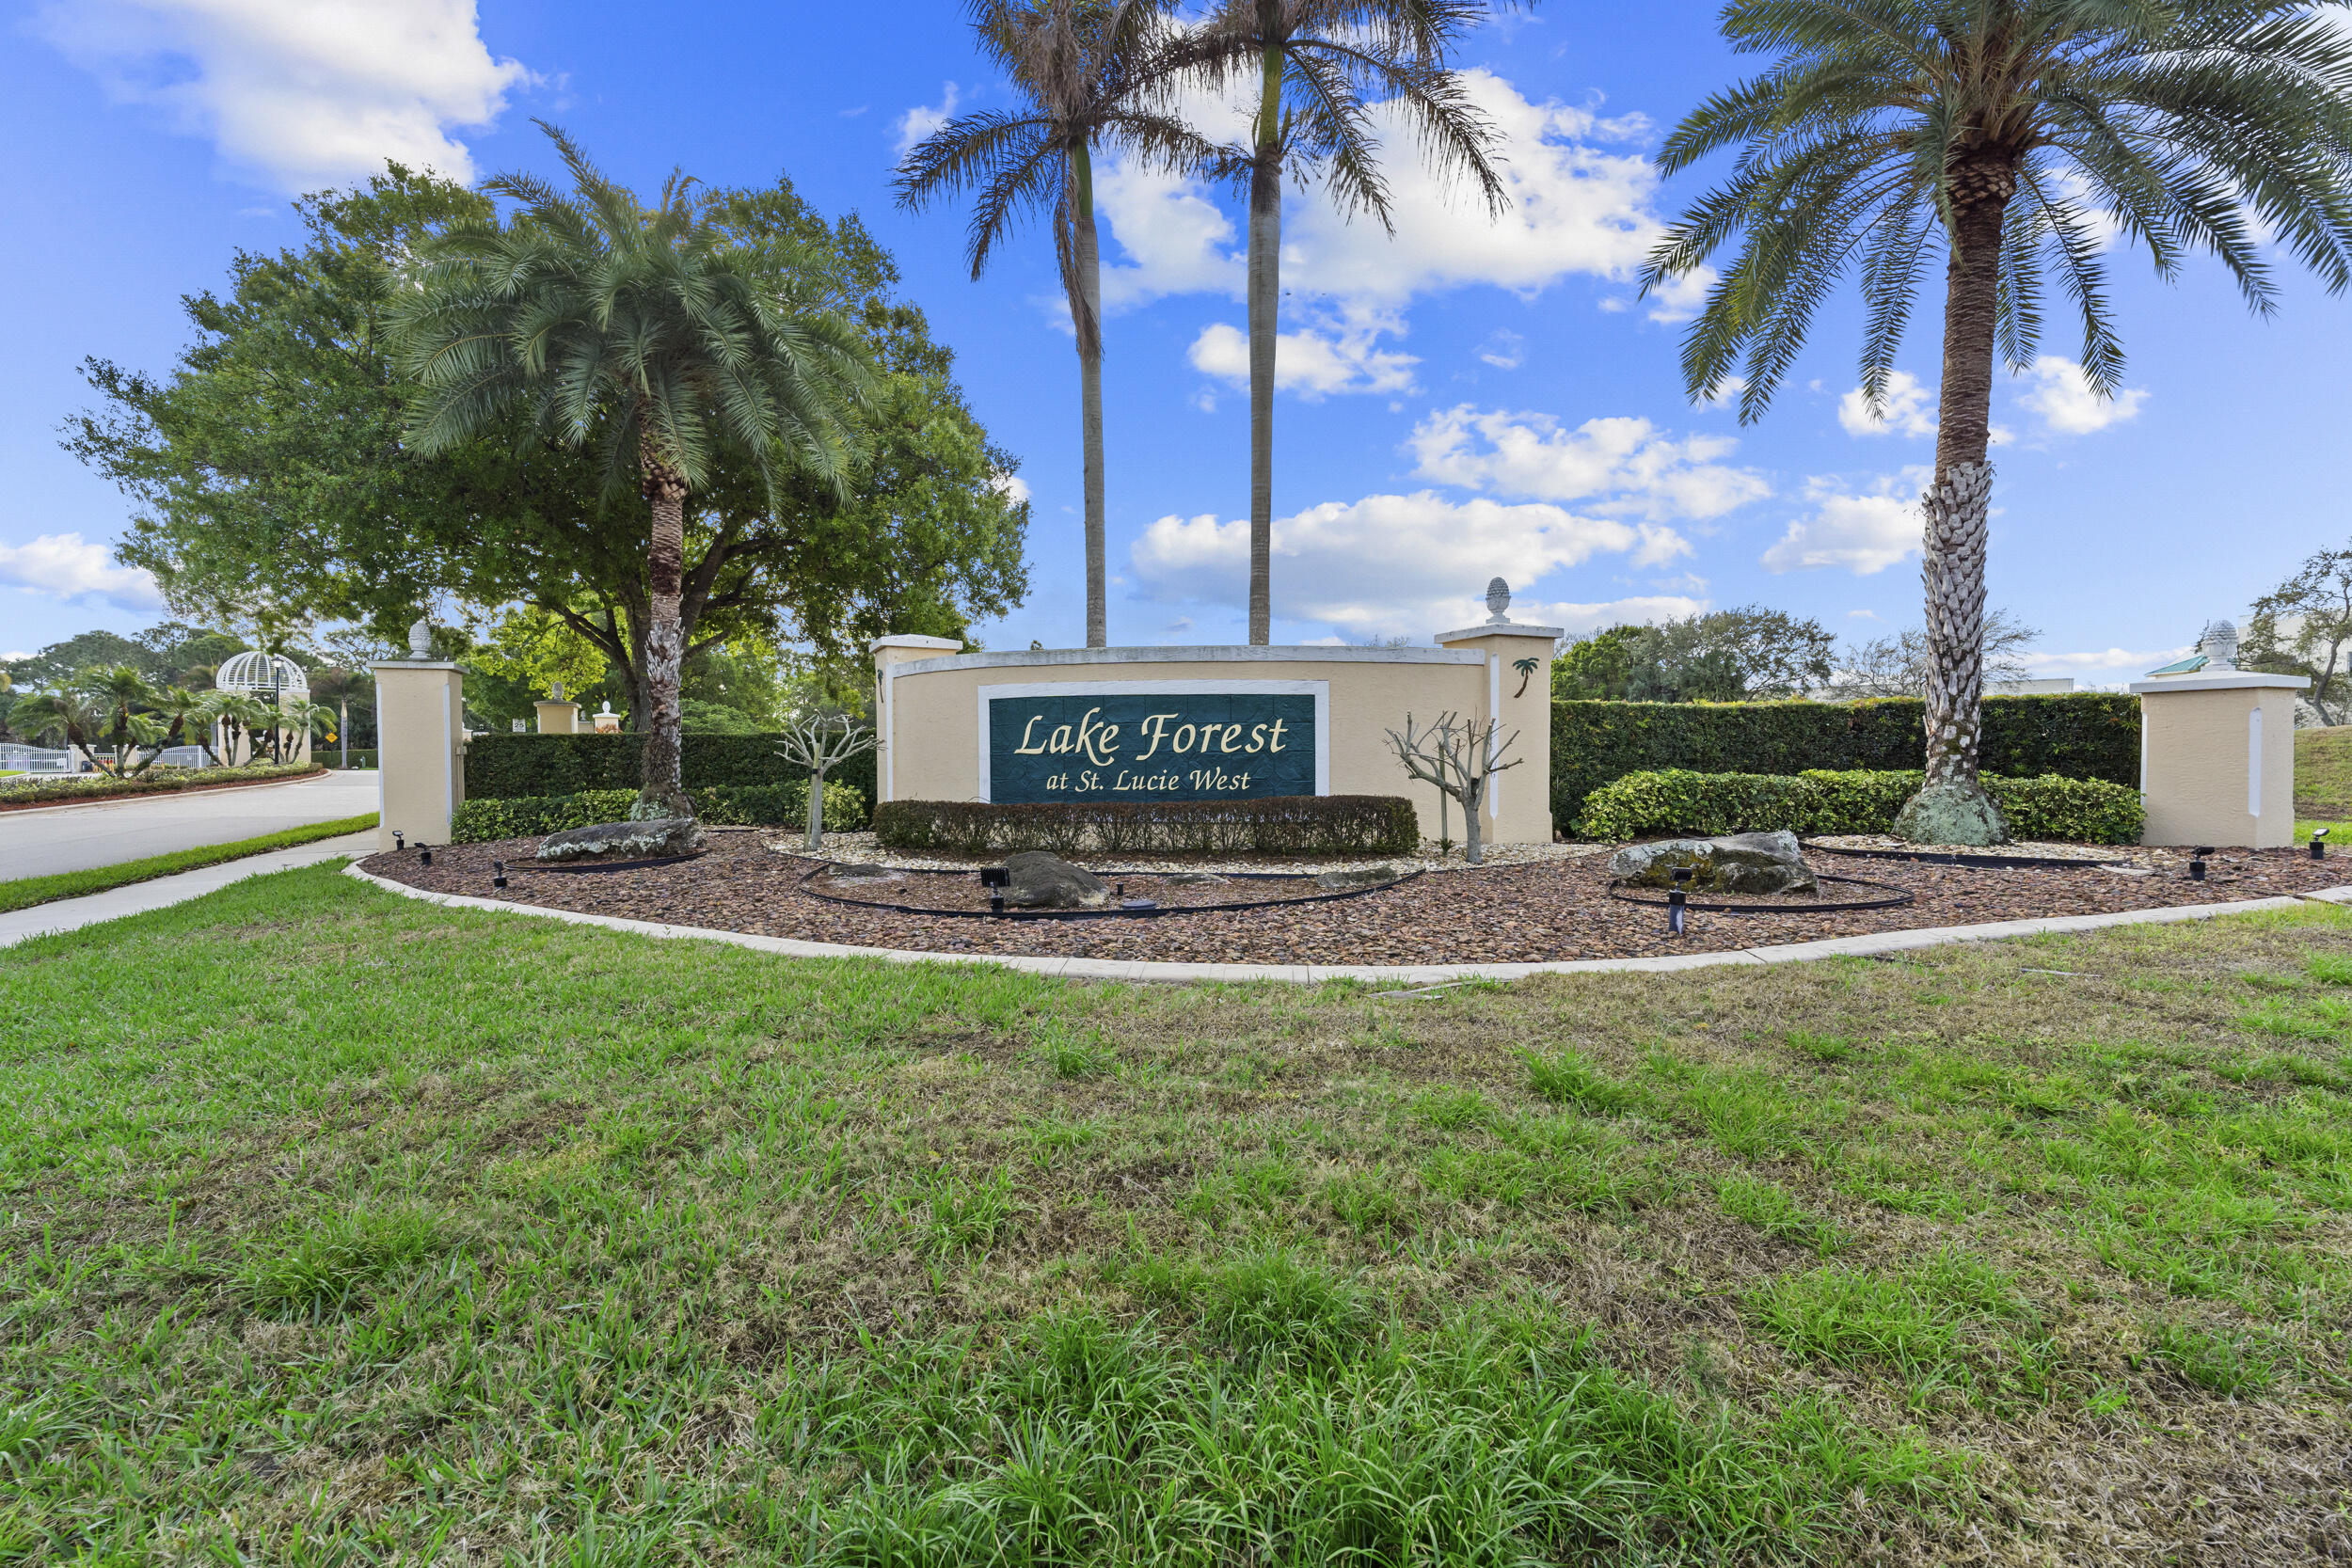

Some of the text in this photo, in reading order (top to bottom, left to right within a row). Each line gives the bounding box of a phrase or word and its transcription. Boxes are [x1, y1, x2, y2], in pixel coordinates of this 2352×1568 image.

[1014, 707, 1289, 767] Lake Forest
[1046, 767, 1251, 792] at St. Lucie West
